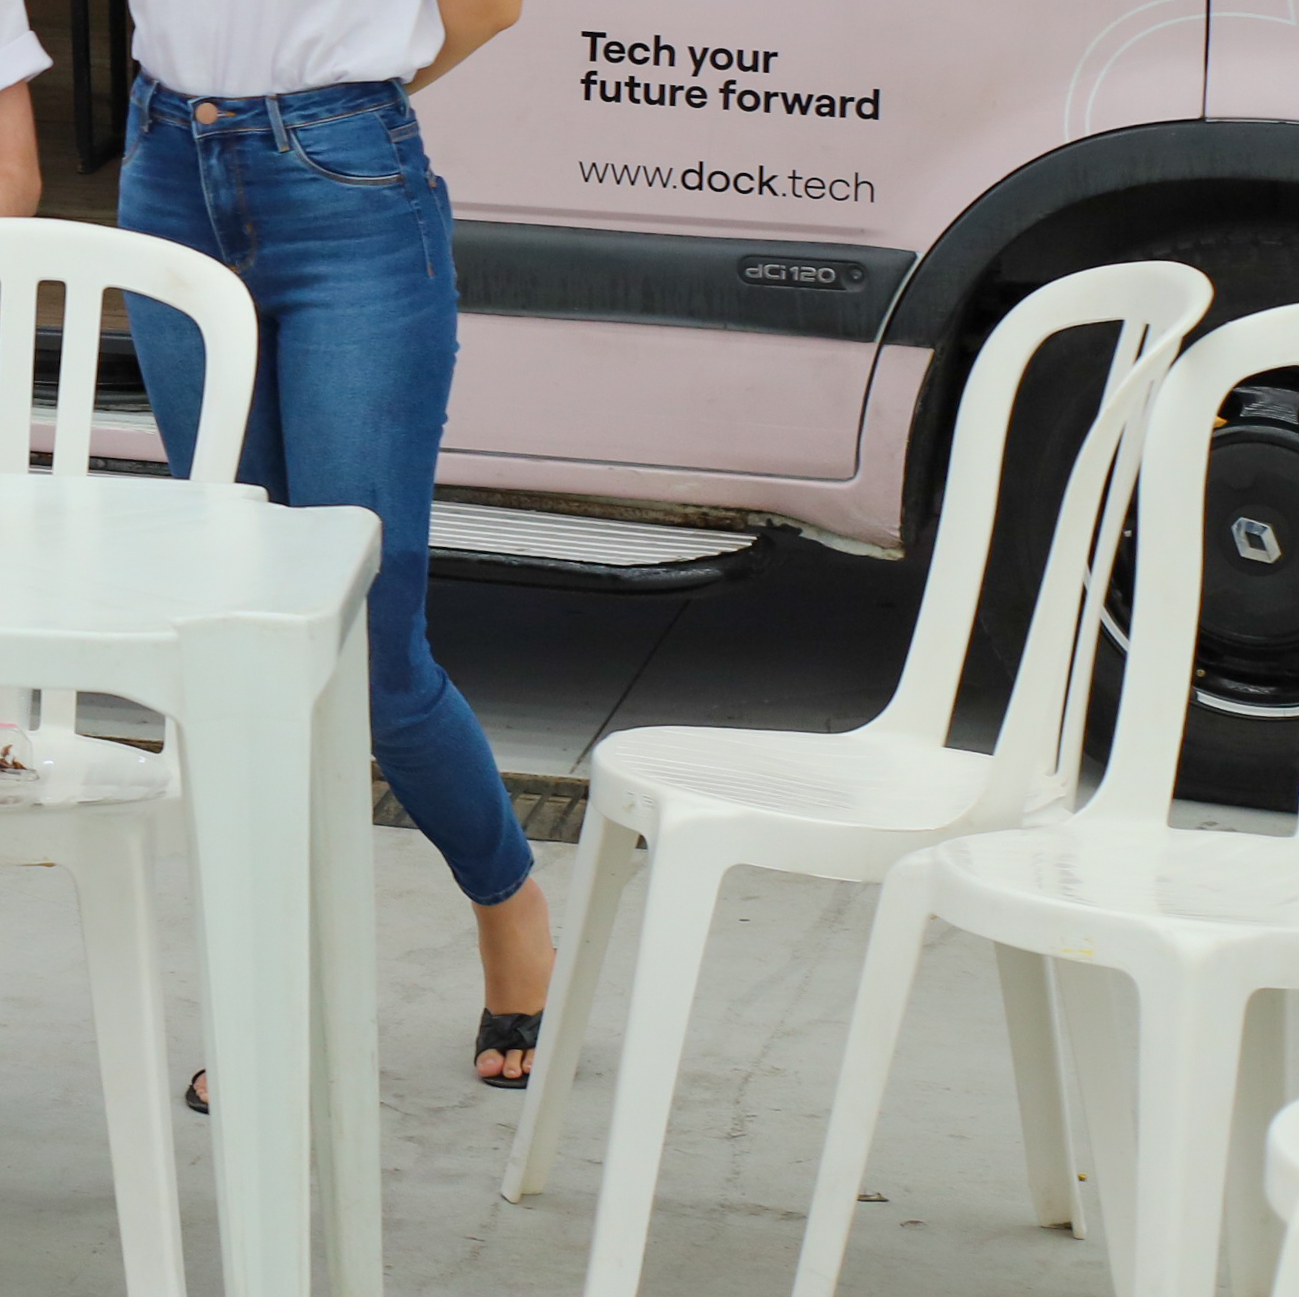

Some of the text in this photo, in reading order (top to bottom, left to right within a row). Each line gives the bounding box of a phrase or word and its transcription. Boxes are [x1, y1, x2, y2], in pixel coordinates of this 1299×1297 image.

[580, 30, 779, 77] Tech your
[580, 70, 881, 120] future forward
[578, 160, 876, 203] www.dock.tech
